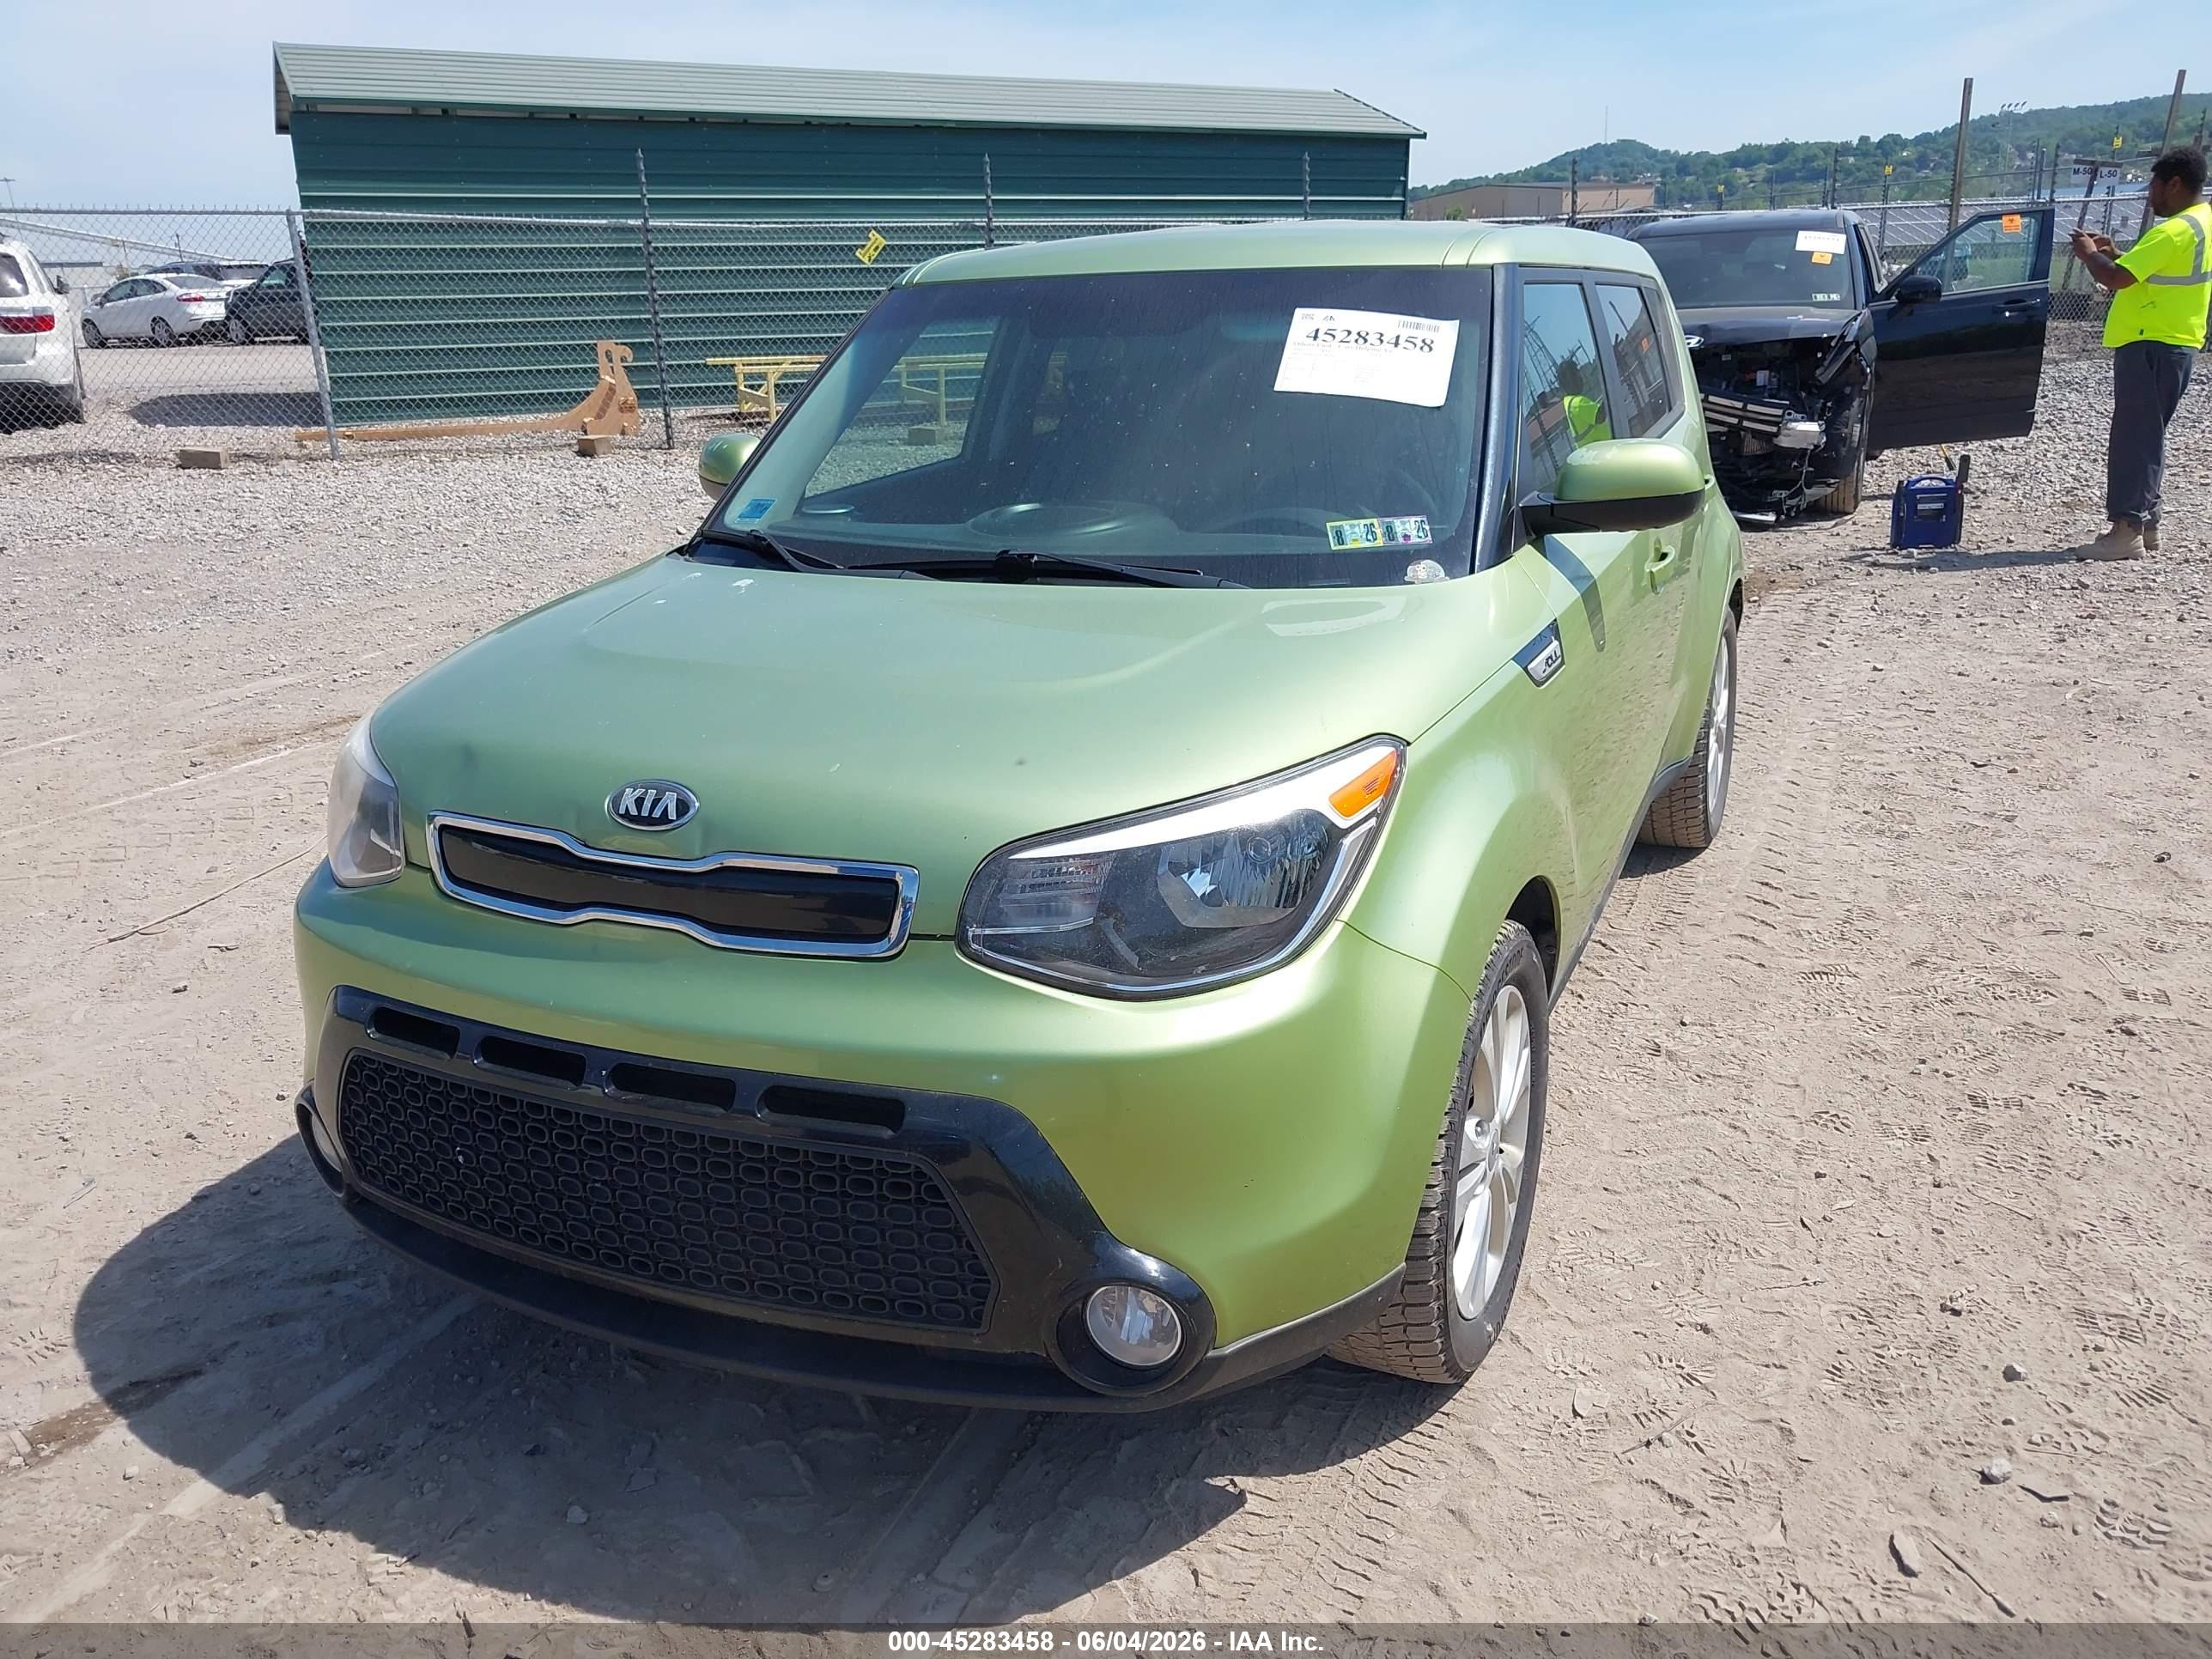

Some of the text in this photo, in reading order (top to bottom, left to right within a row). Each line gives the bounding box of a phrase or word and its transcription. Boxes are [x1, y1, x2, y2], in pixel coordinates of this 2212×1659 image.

[2073, 167, 2093, 175] M-50
[2100, 169, 2118, 179] L-50
[1305, 327, 1435, 353] 45283458
[1364, 523, 1378, 543] 26
[618, 787, 678, 821] KIA
